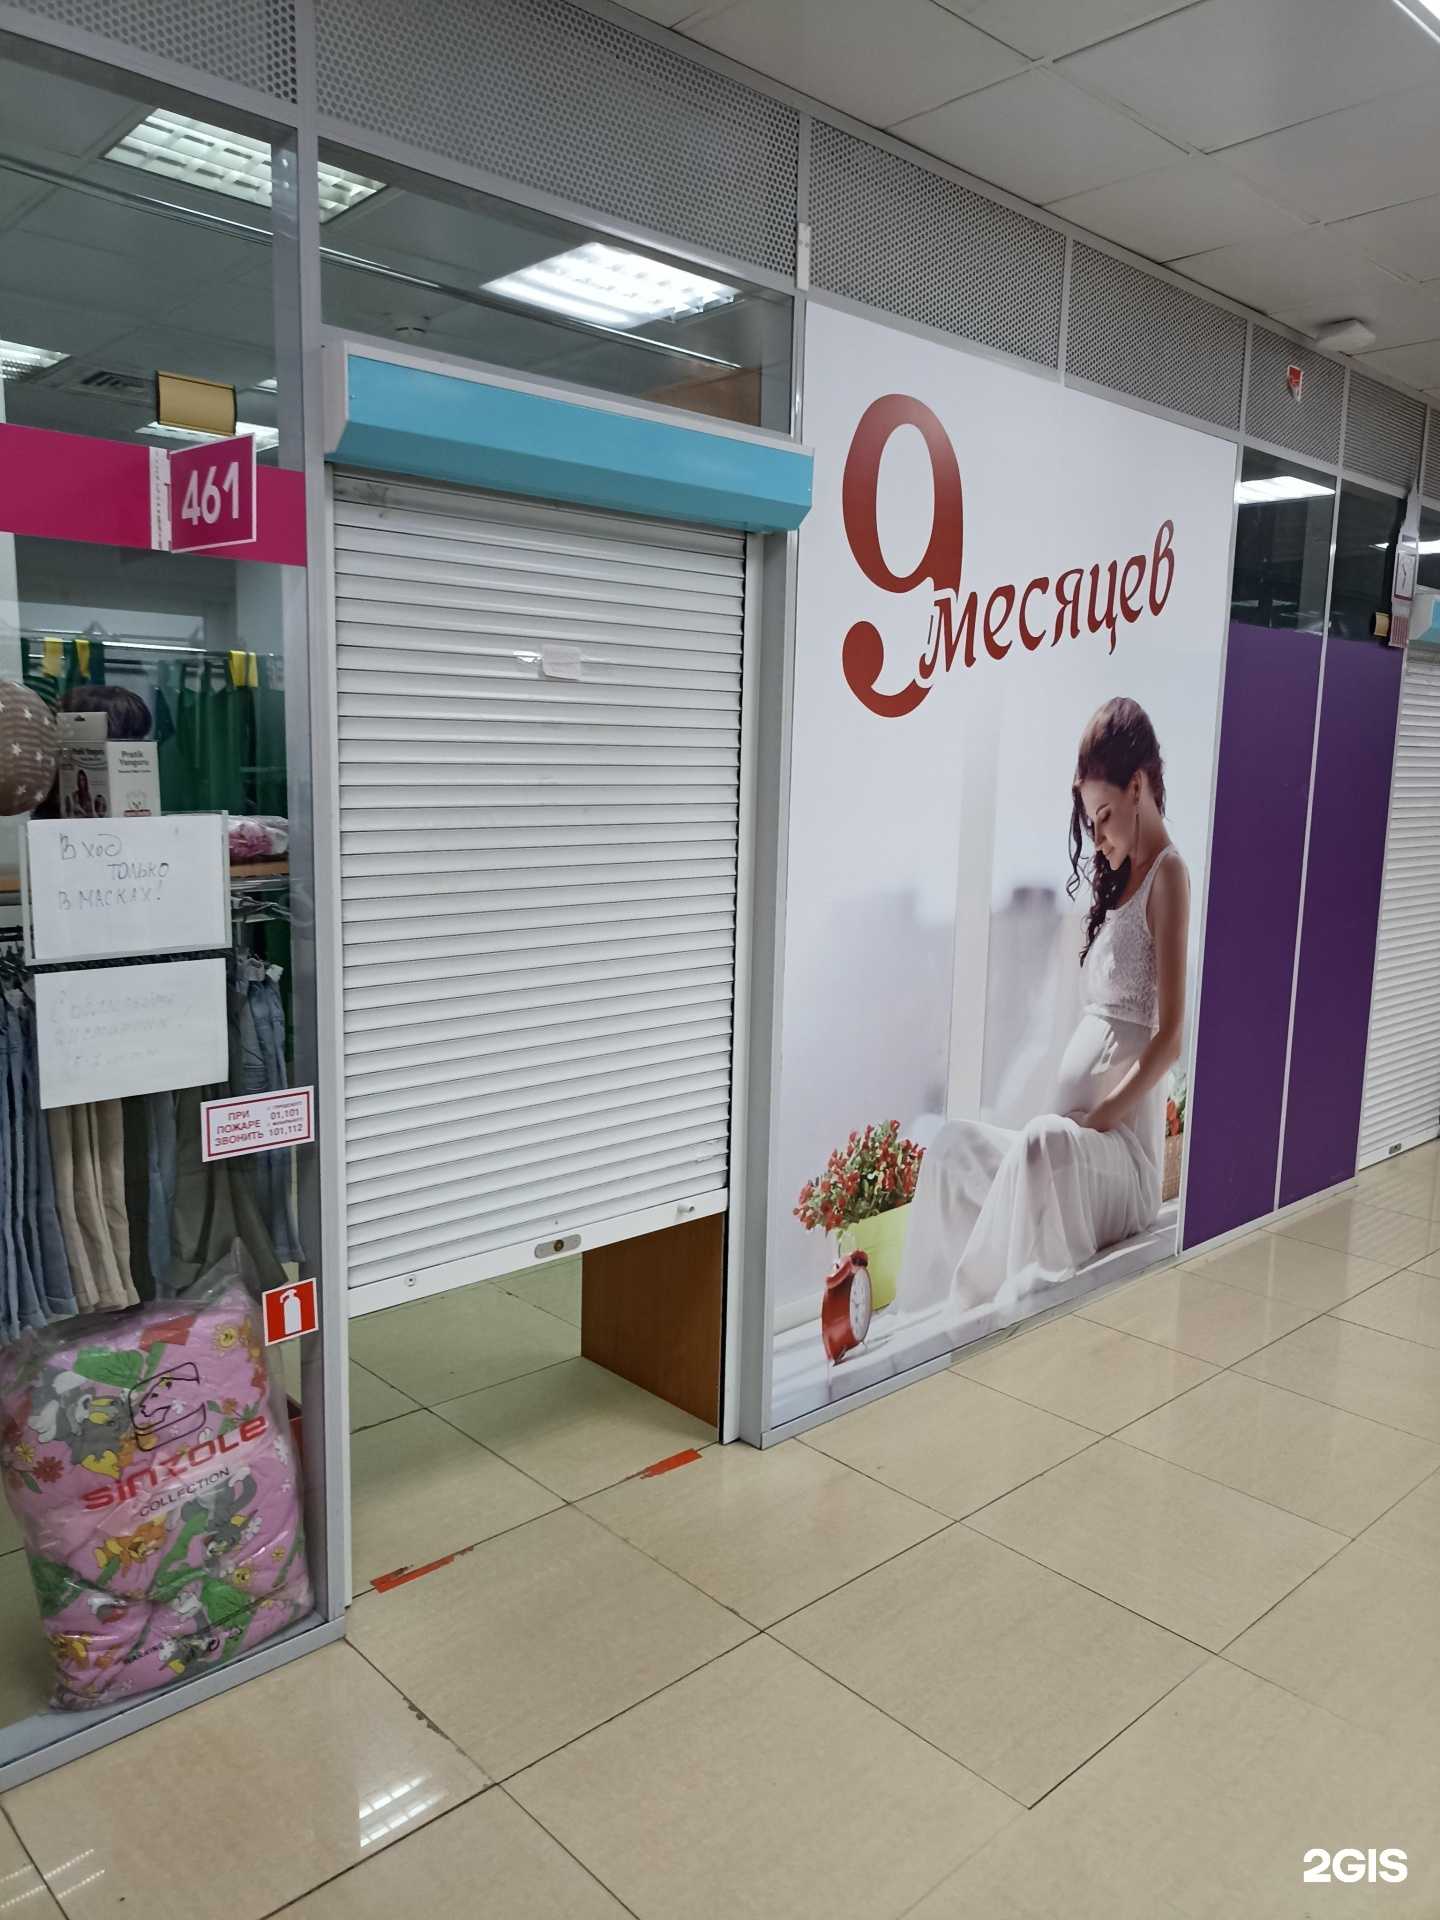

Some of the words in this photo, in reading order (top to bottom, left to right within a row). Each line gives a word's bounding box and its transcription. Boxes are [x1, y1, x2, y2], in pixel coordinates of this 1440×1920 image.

[181, 461, 240, 526] 461
[842, 393, 964, 718] 9
[919, 519, 1175, 679] месяцев
[215, 1131, 265, 1147] ЗВОНИТЬ
[217, 1119, 262, 1135] ПОЖАРЕ
[228, 1110, 251, 1121] ПРИ
[139, 1467, 231, 1517] COLLECTION
